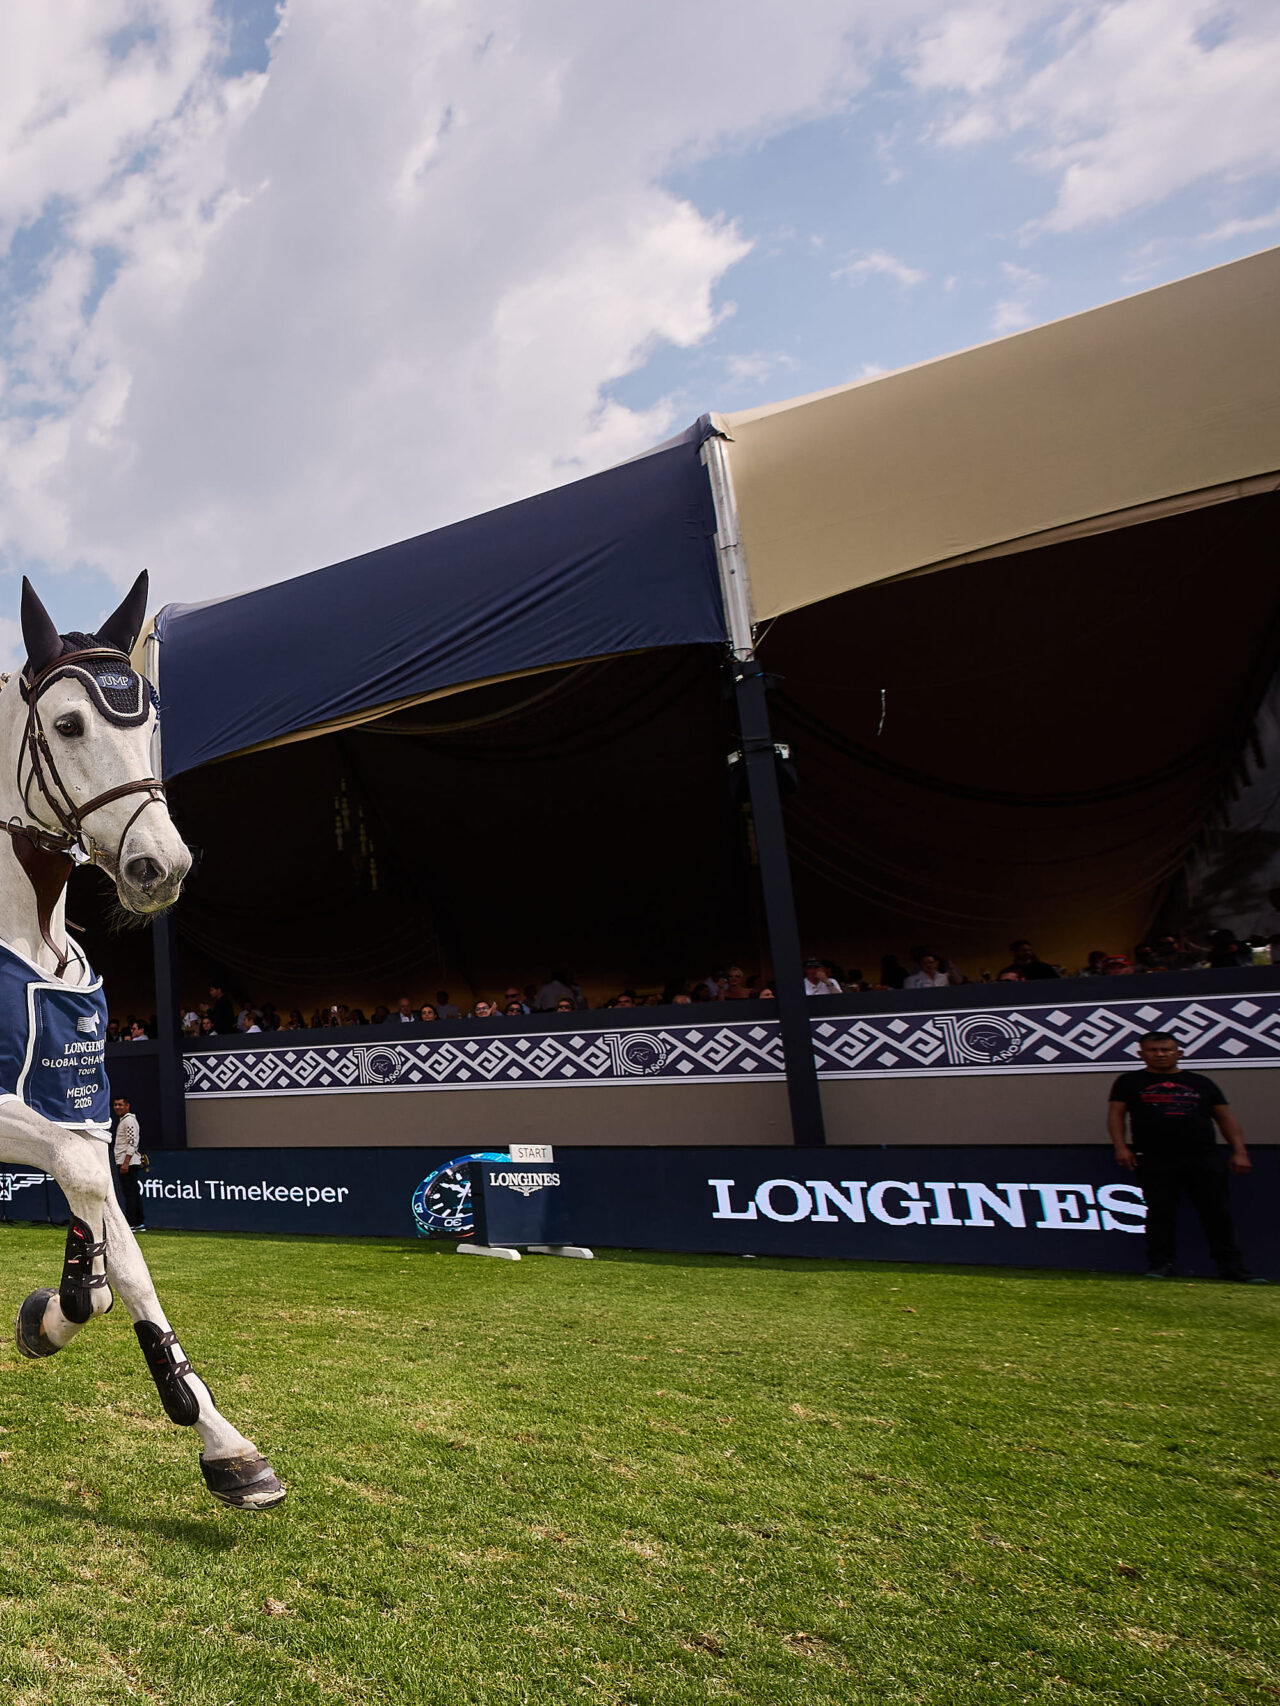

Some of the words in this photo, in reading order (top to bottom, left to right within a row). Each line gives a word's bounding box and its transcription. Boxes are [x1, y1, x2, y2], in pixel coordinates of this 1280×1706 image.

[100, 676, 129, 687] JUMP
[42, 1056, 78, 1068] GLOBAL
[78, 1067, 96, 1075] TOUR
[66, 1083, 99, 1099] MEXICO
[74, 1096, 93, 1109] 2026
[518, 1148, 547, 1158] START
[489, 1172, 561, 1187] LONGINES
[204, 1180, 350, 1208] Timekeeper
[707, 1178, 1149, 1234] LONGINES
